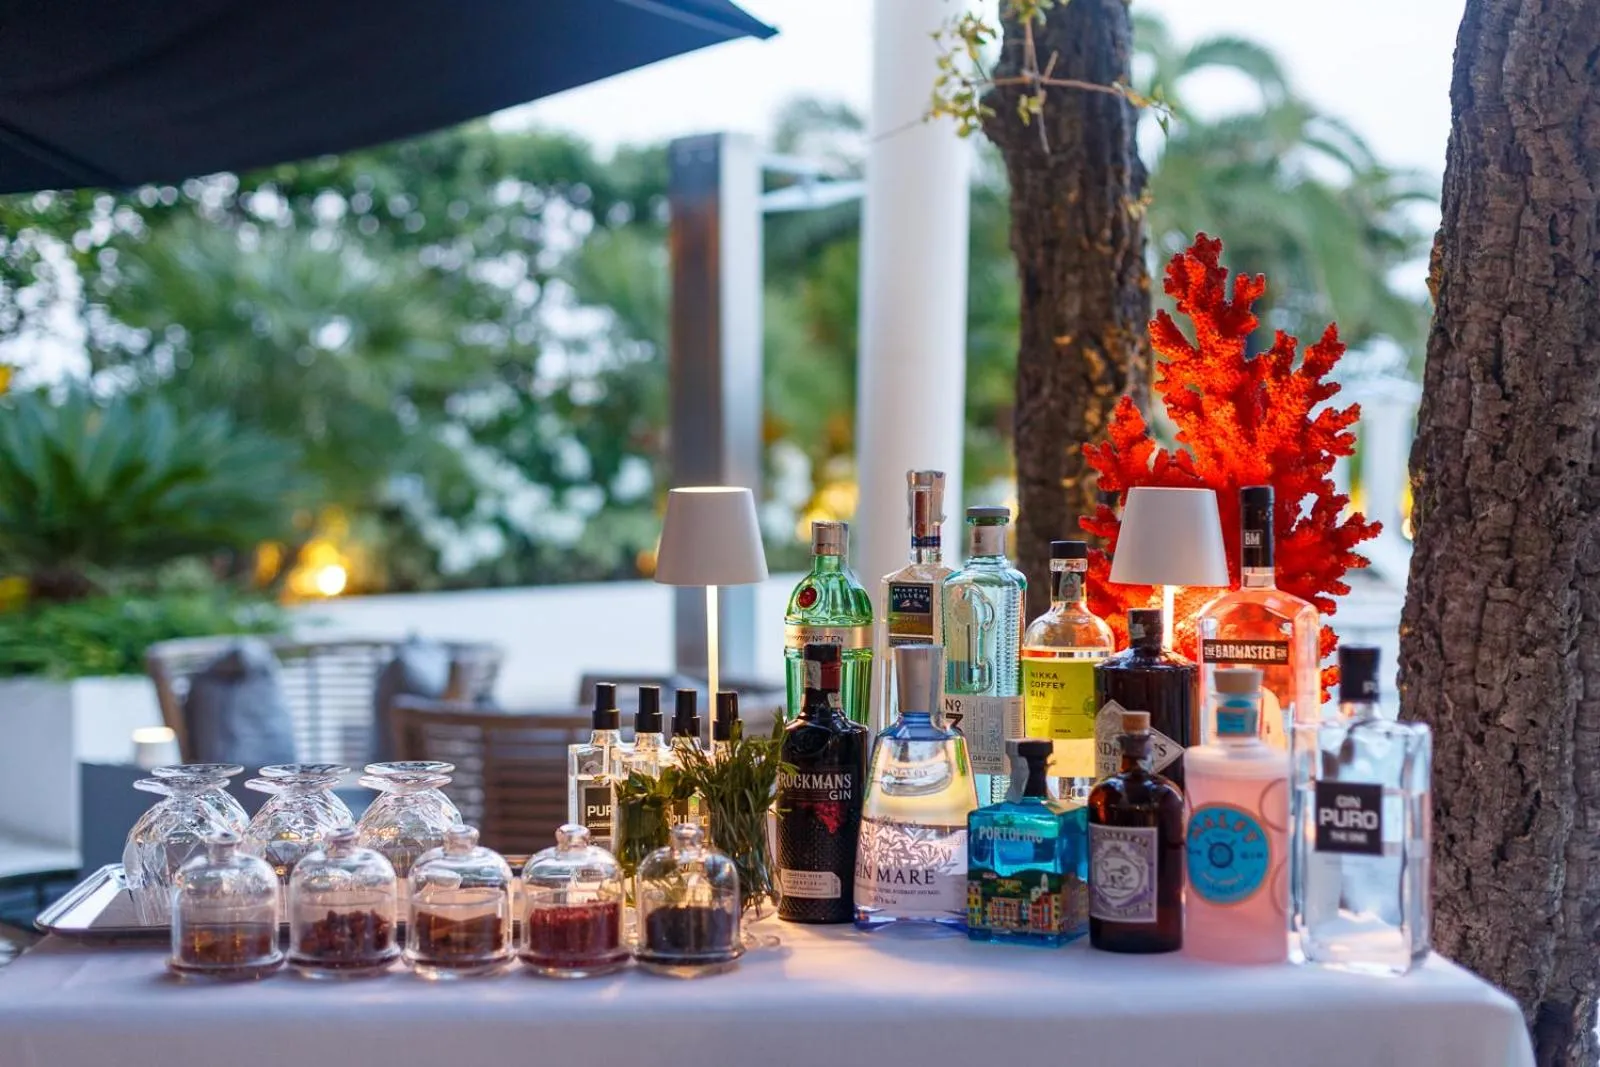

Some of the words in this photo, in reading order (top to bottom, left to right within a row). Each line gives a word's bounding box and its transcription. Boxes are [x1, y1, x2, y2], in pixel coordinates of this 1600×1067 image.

[1245, 532, 1260, 545] BM
[824, 635, 843, 643] TEN
[1215, 644, 1276, 660] BARMASTER
[1030, 671, 1058, 680] NIKKA
[1030, 681, 1066, 689] COFFEY
[1030, 690, 1046, 698] GIN
[829, 789, 852, 800] GIN
[1335, 794, 1362, 809] GIN
[1319, 807, 1379, 830] PURO
[876, 868, 936, 886] MARE
